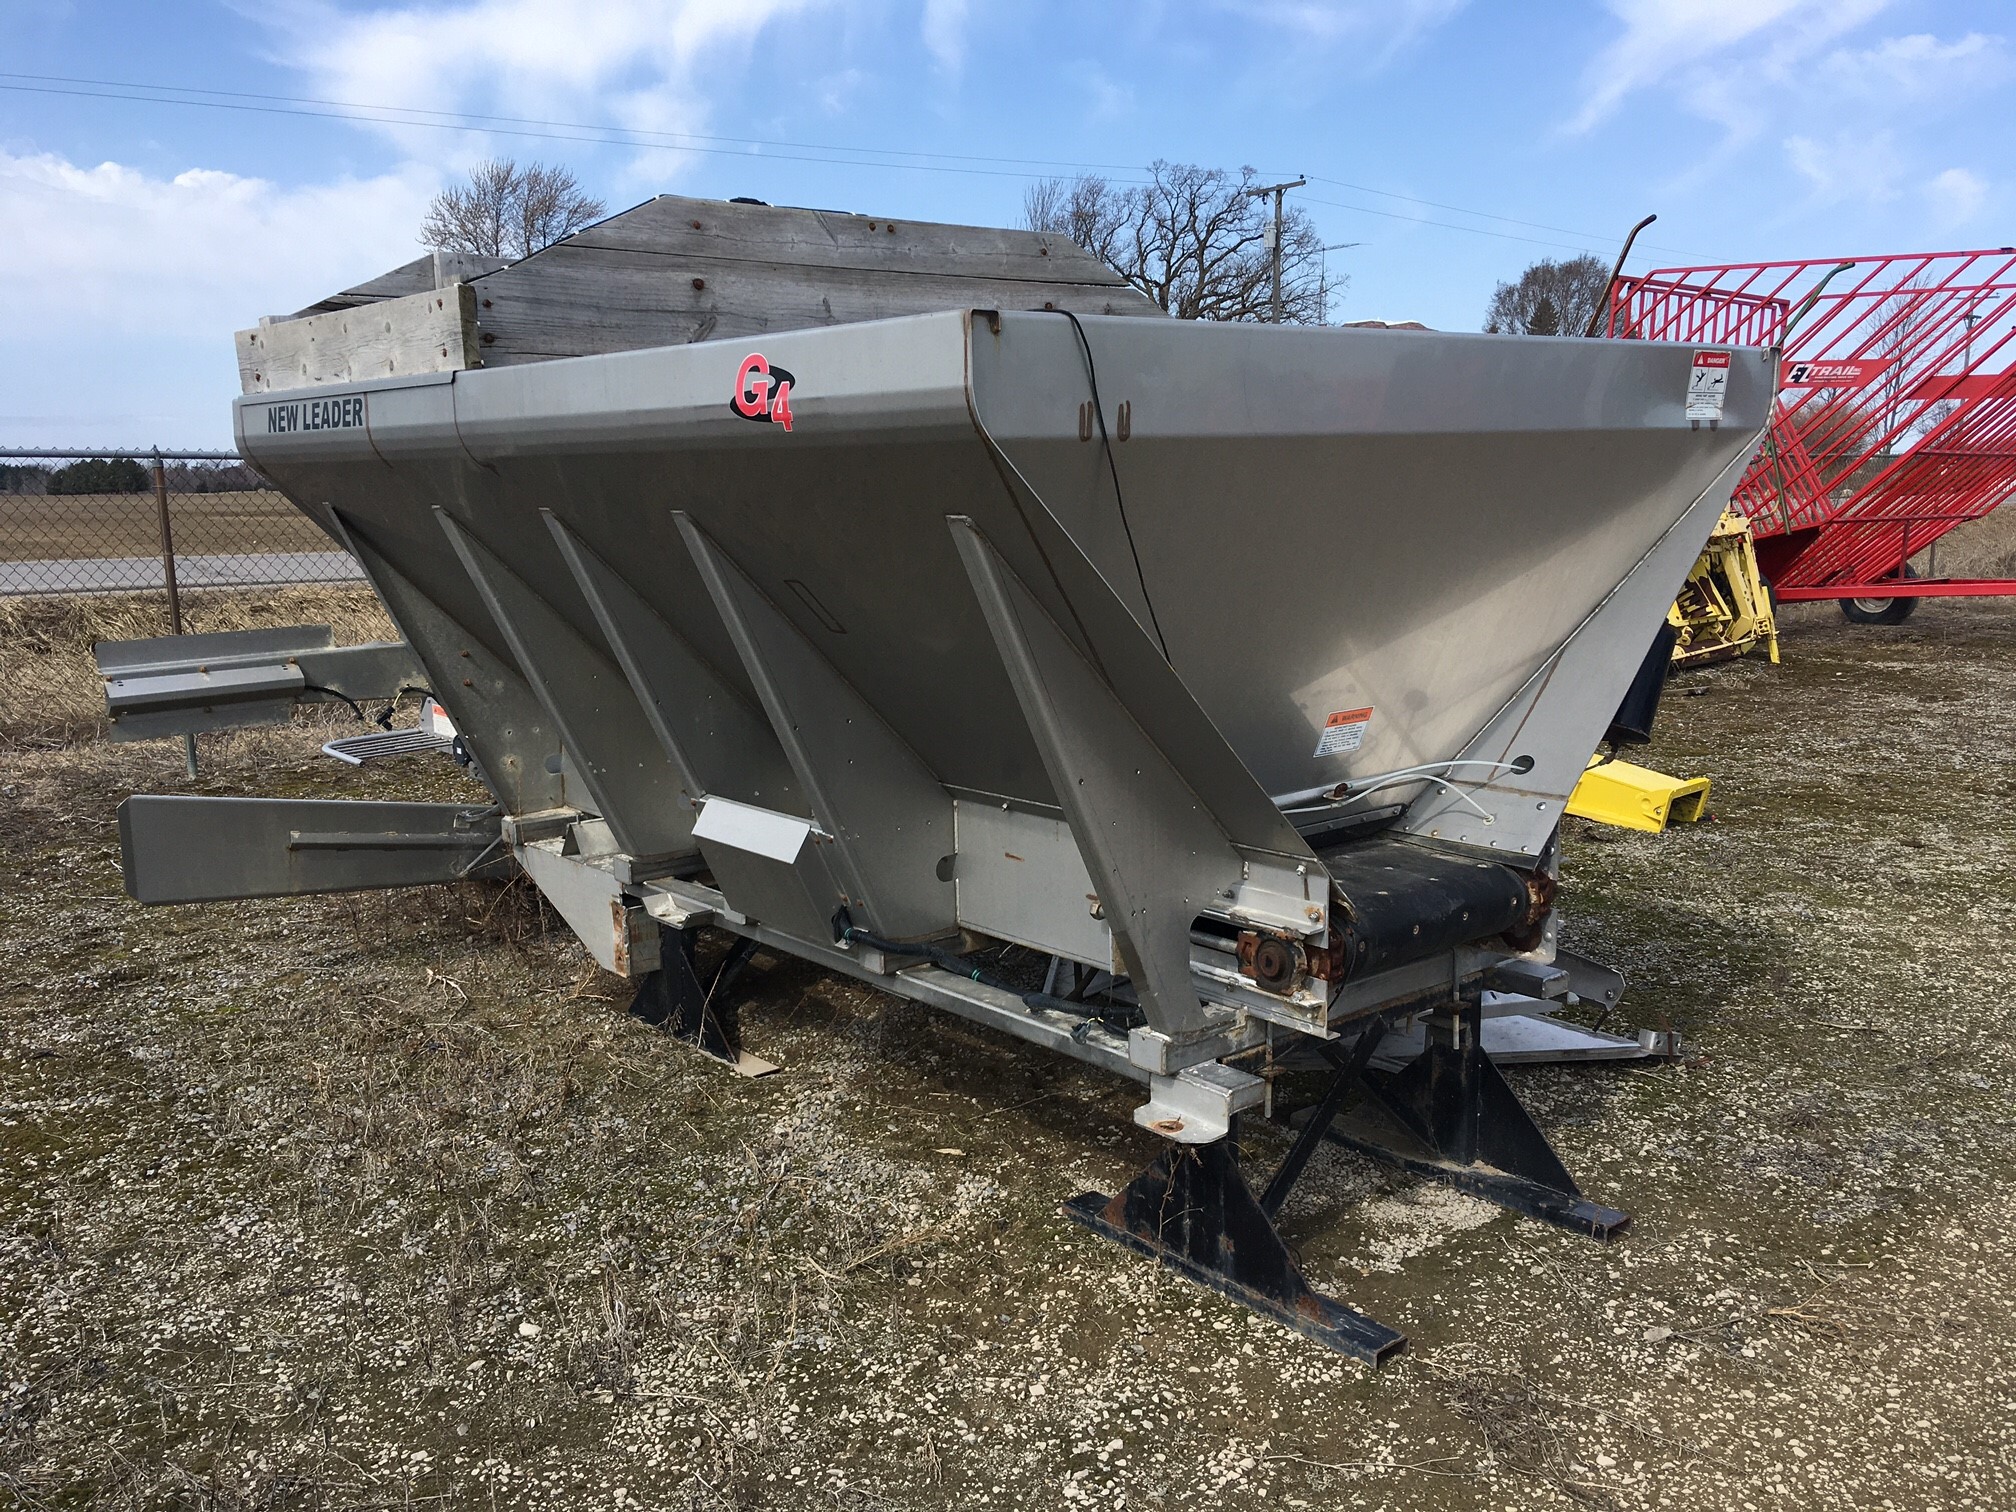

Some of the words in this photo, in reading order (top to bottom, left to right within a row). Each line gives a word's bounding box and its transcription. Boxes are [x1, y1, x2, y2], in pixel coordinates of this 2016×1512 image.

[1810, 365, 1861, 376] TRAIL
[735, 352, 794, 432] G4
[268, 404, 299, 433] NEW
[303, 398, 363, 431] LEADER
[1342, 711, 1368, 721] WARNING
